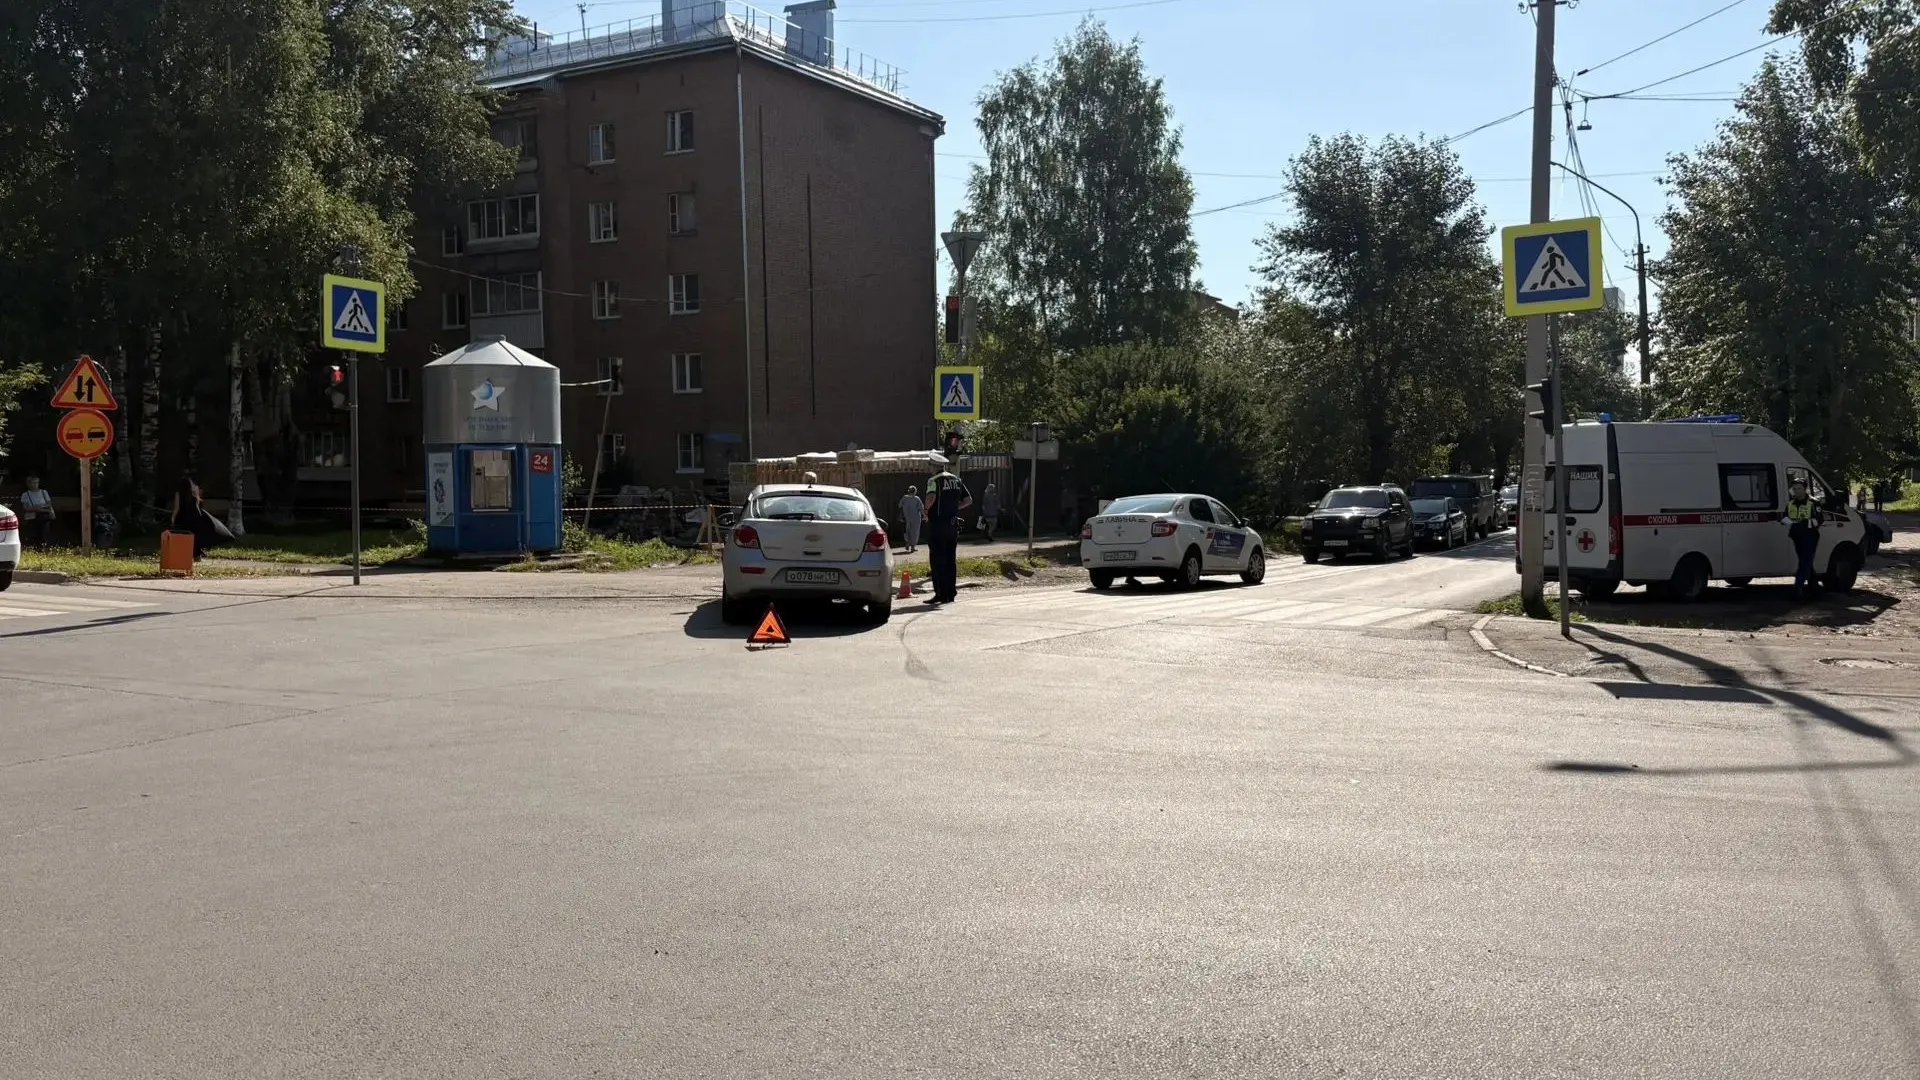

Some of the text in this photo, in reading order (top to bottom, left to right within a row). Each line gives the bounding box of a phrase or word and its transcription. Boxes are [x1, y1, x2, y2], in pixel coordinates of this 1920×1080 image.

[534, 454, 548, 466] 24
[1570, 471, 1598, 480] НАШИХ
[942, 479, 961, 490] ДПС
[1647, 513, 1759, 524] СКОРАЯ МЕДИЦИНСКАЯ
